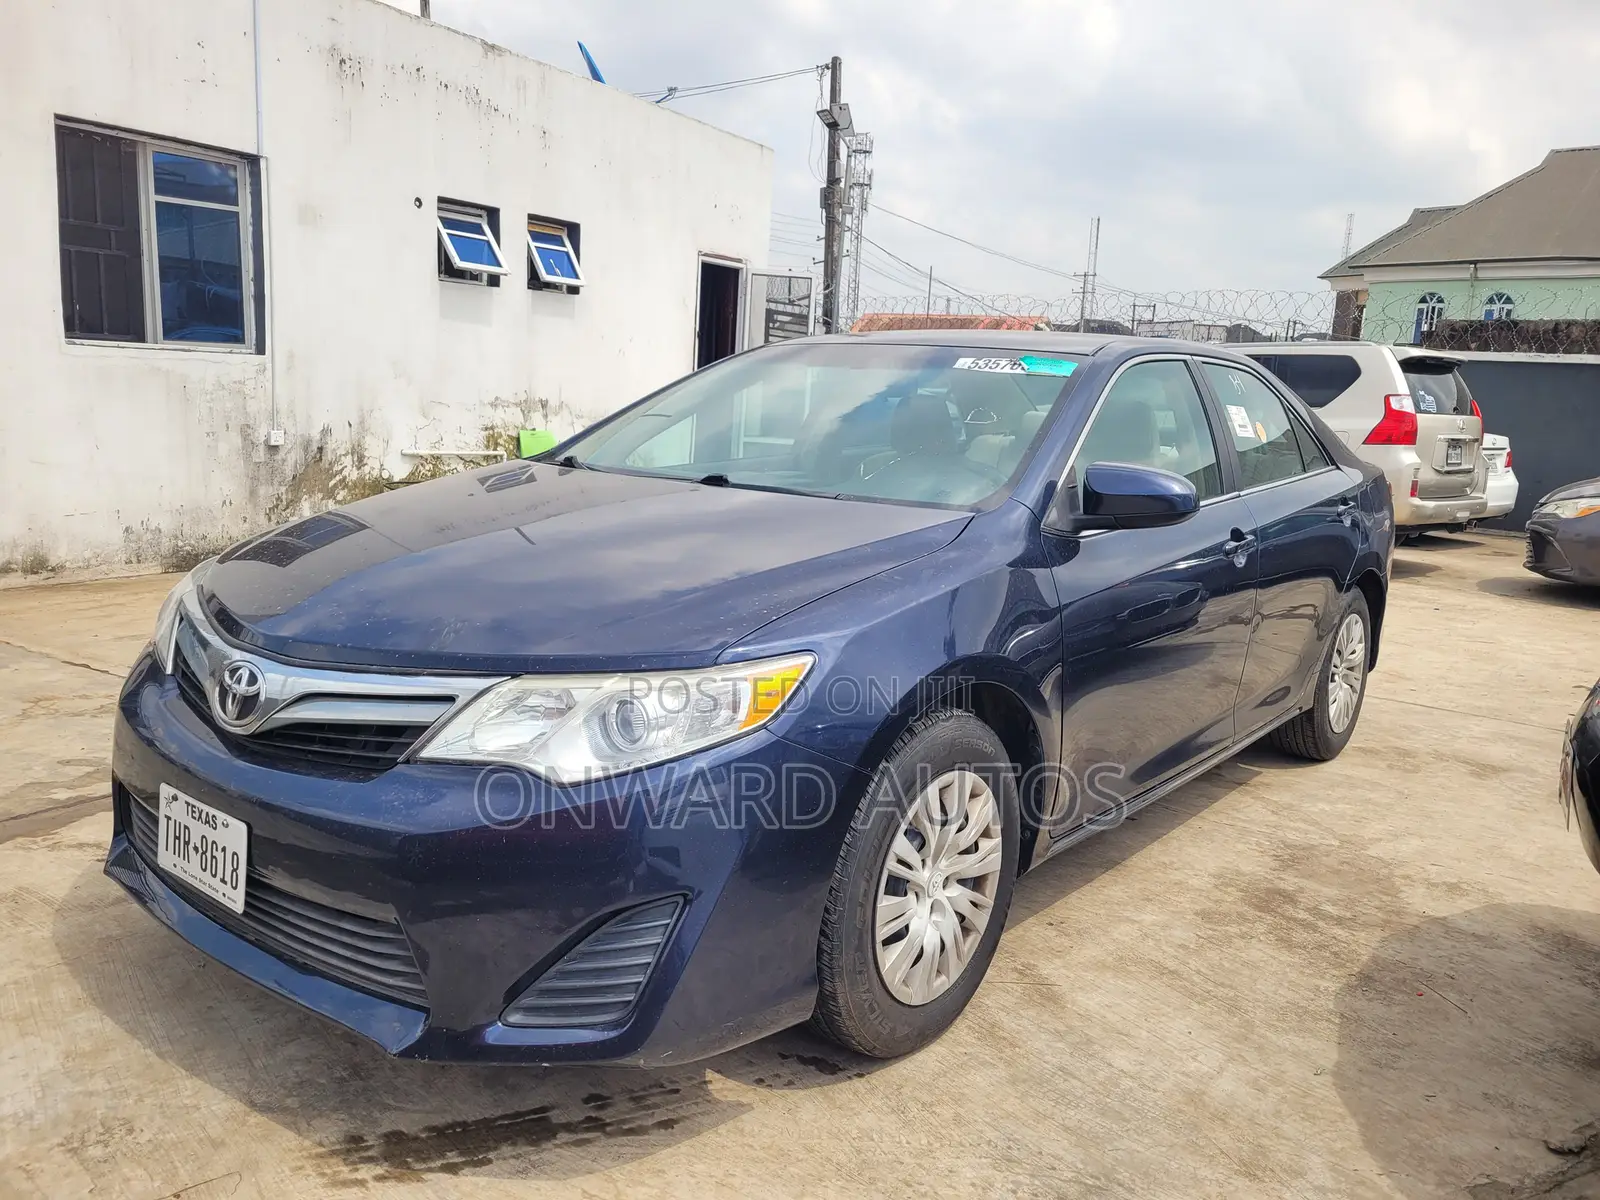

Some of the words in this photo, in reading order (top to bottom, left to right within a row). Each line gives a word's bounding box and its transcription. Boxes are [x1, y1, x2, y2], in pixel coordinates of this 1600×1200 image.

[184, 800, 218, 831] TEXAS
[164, 813, 191, 864] THR
[200, 834, 240, 891] 8618
